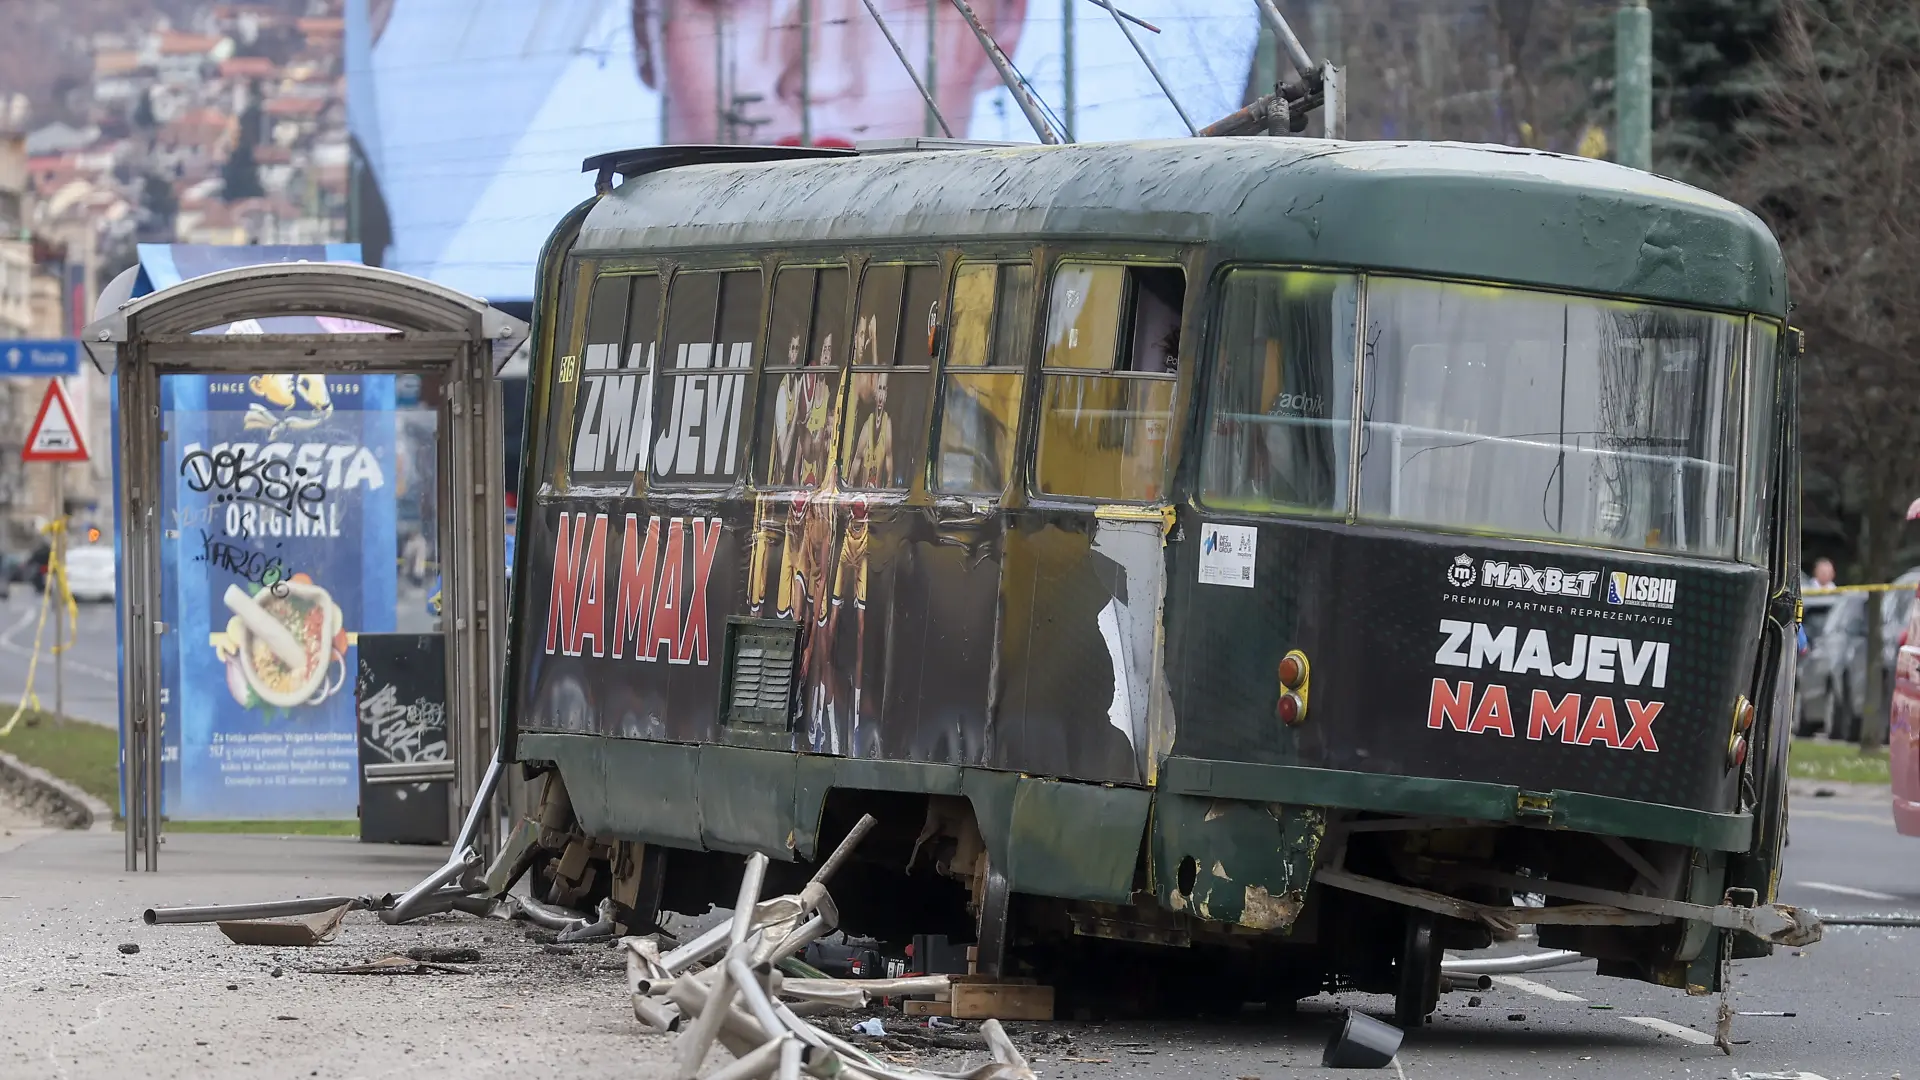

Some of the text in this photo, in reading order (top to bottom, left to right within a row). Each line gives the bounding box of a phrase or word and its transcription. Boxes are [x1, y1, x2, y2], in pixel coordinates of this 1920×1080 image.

[209, 383, 245, 393] SINCE
[573, 341, 752, 476] ZMAJEVI
[184, 442, 384, 490] VEGETA
[226, 503, 341, 537] ORIGINAL
[545, 512, 722, 666] NA MAX
[1443, 593, 1673, 626] PREMIUM PARTNER REPREZENTACIJE
[1625, 574, 1677, 604] KSBIH
[1435, 619, 1670, 688] ZMAJEVI
[1427, 677, 1665, 752] NA MAX
